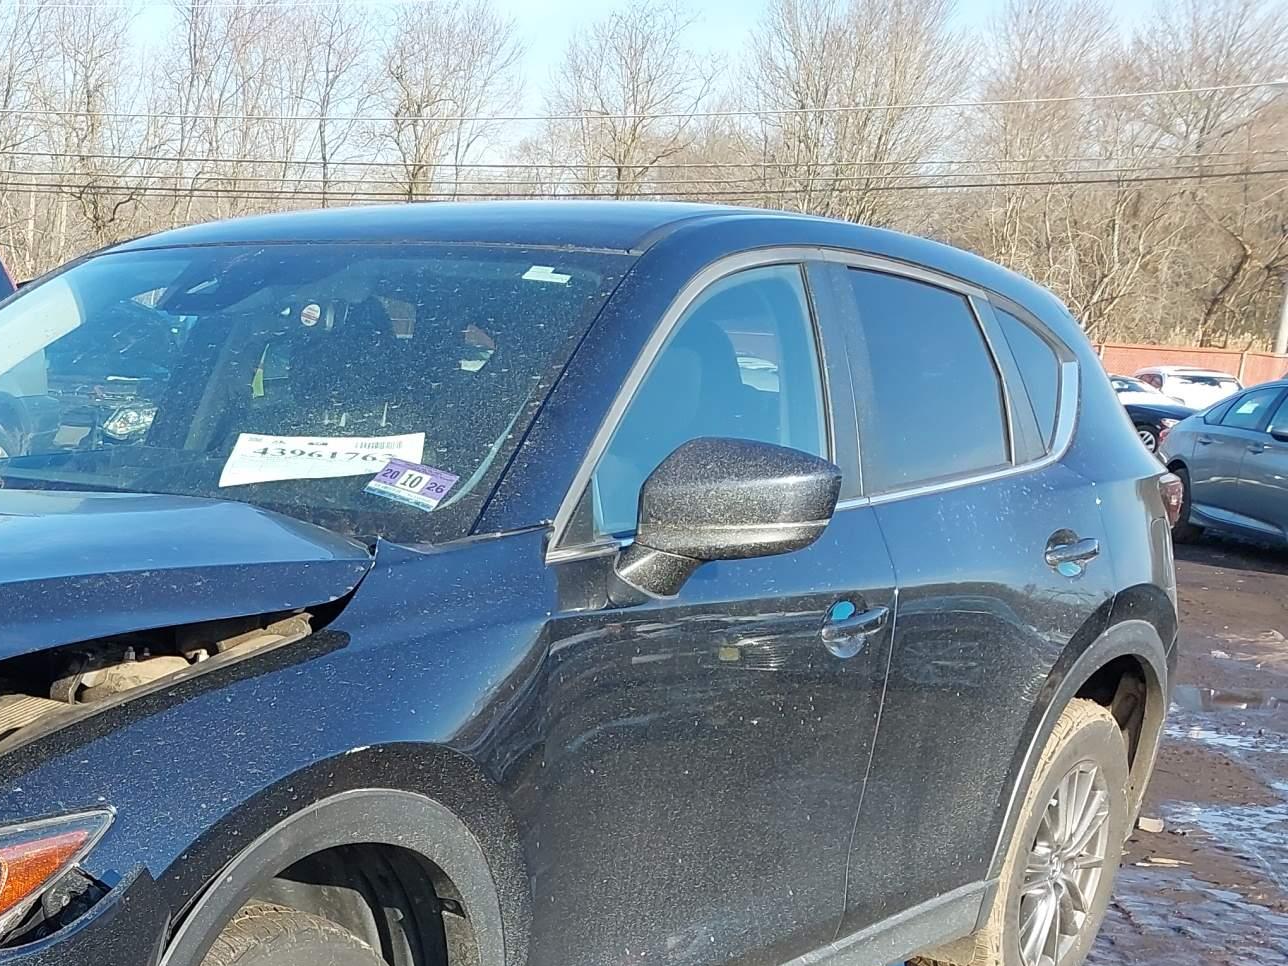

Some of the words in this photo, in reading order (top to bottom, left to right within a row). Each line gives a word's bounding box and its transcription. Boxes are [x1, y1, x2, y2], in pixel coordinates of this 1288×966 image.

[382, 468, 401, 480] 20
[399, 473, 423, 489] 10
[425, 481, 446, 494] 26
